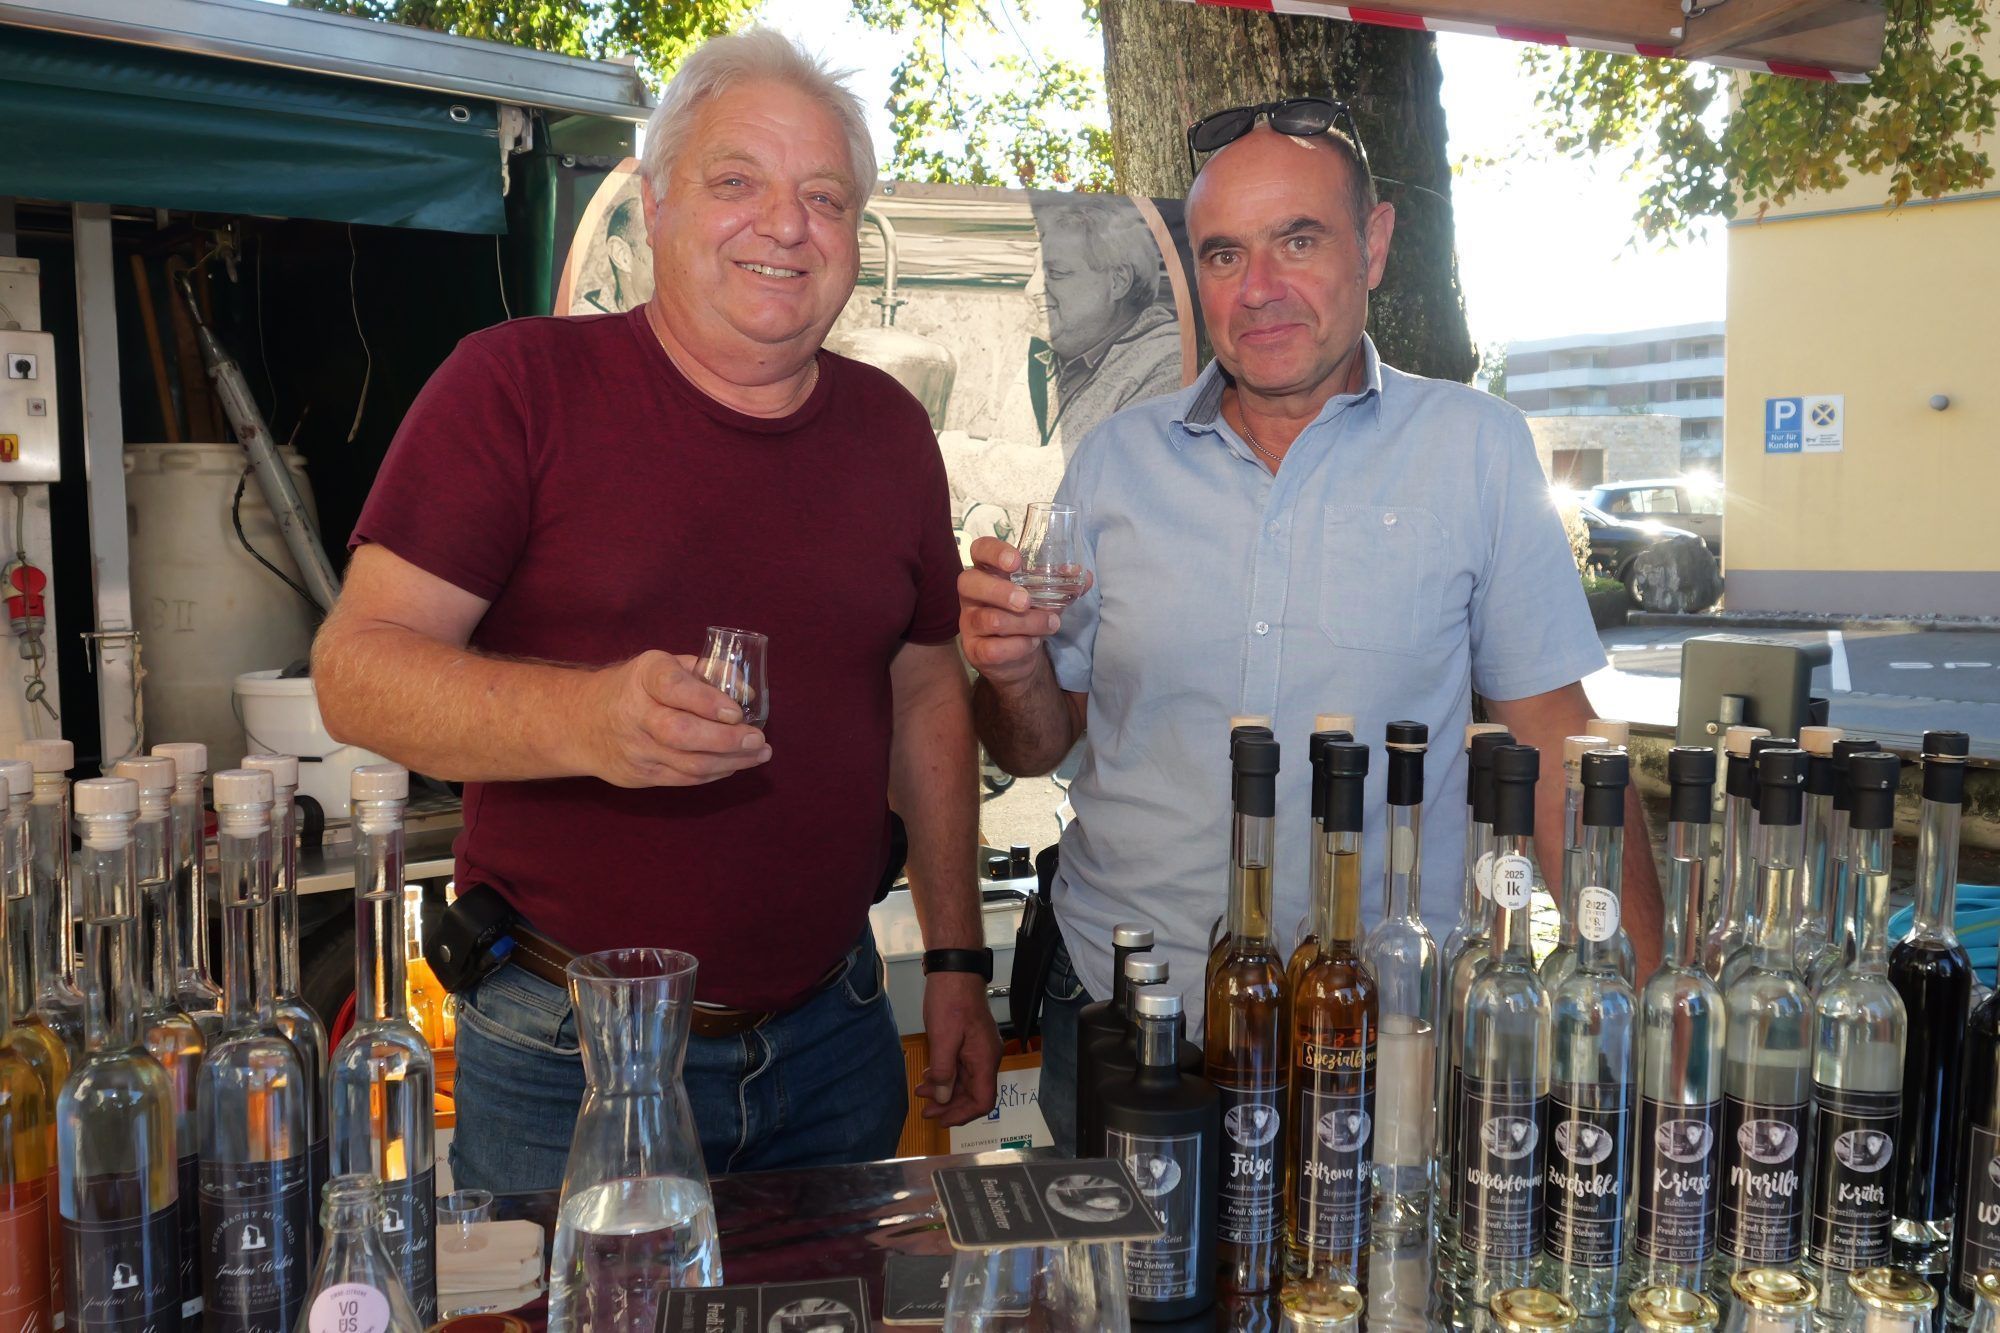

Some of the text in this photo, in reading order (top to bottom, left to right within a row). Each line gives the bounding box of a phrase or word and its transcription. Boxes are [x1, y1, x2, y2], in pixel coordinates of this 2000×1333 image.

[1775, 400, 1797, 430] P
[1771, 433, 1797, 442] Nur für
[1768, 441, 1799, 449] Kunden
[1504, 870, 1525, 879] 2025
[1000, 1083, 1018, 1096] RK
[999, 1088, 1038, 1108] ALITÄ
[1000, 1134, 1033, 1143] FELDKIRCH
[1230, 1152, 1271, 1180] Feige
[1731, 1165, 1799, 1198] Marilla
[1144, 1260, 1175, 1270] Sieberer
[338, 1300, 358, 1316] VO
